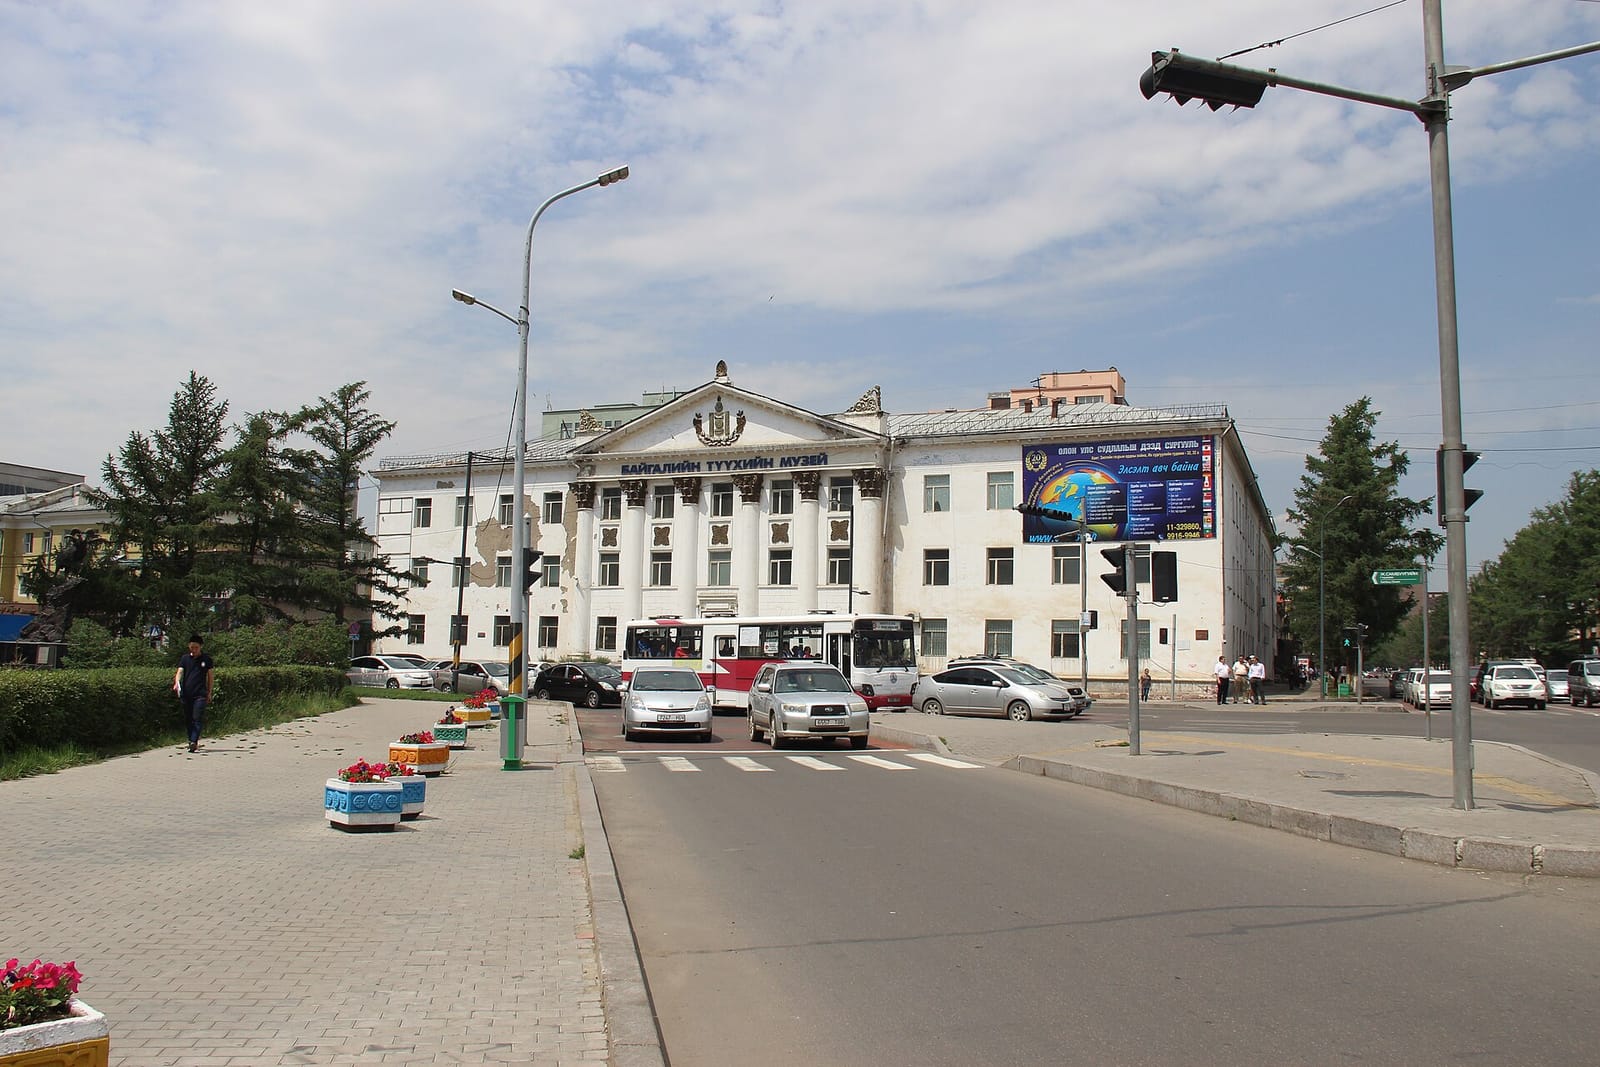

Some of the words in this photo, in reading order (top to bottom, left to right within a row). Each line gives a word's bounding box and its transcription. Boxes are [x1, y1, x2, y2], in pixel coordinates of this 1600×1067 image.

[1058, 447, 1077, 455] ОЛОН
[1080, 446, 1094, 455] УЛС
[1097, 443, 1137, 454] СУДЛАЛЫН
[1140, 442, 1161, 451] ДЭЭД
[1164, 440, 1199, 449] СУРГУУЛЬ
[621, 461, 700, 475] БАЙГАЛИЙН
[706, 455, 774, 471] ТҮҮХИЙН
[779, 452, 829, 468] МУЗЕЙ
[1031, 454, 1042, 462] 20
[1118, 463, 1150, 475] Элсэлт
[1152, 464, 1168, 473] авч
[1170, 460, 1199, 472] байна
